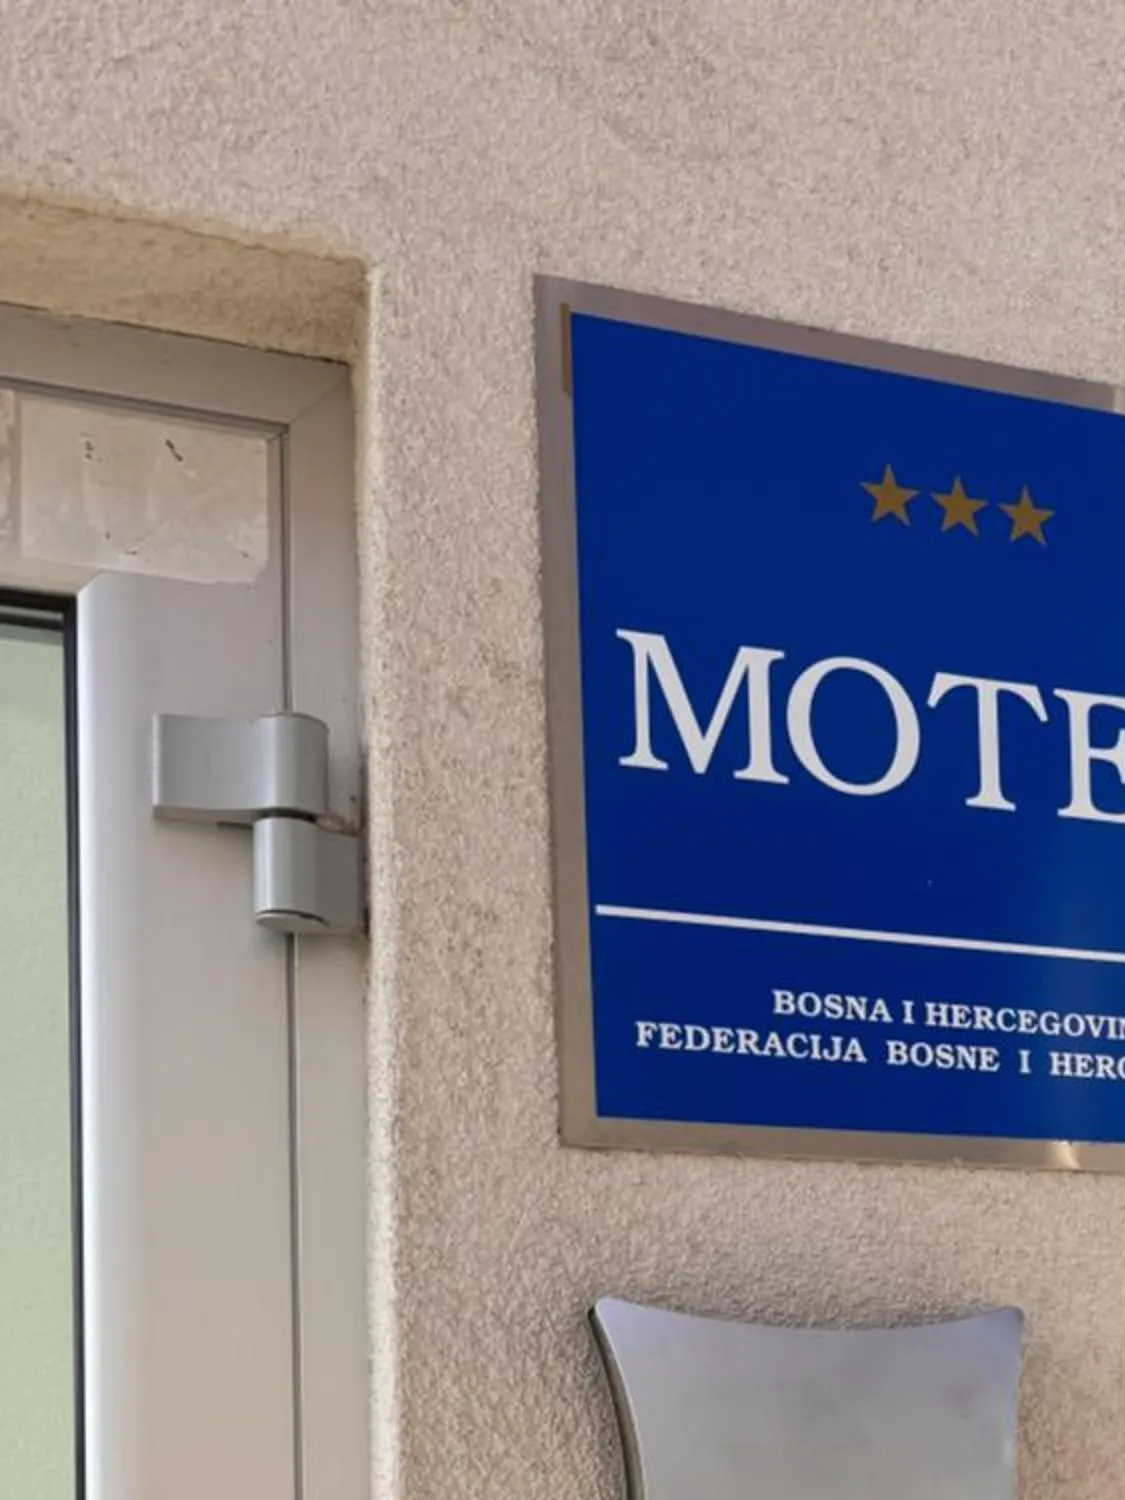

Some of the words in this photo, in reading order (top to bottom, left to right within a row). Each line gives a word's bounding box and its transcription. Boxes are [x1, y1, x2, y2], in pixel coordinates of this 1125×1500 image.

[773, 990, 892, 1022] BOSNA
[903, 1000, 913, 1024] I
[636, 1021, 868, 1062] FEDERACIJA
[887, 1040, 1000, 1071] BOSNE
[1020, 1050, 1030, 1073] I
